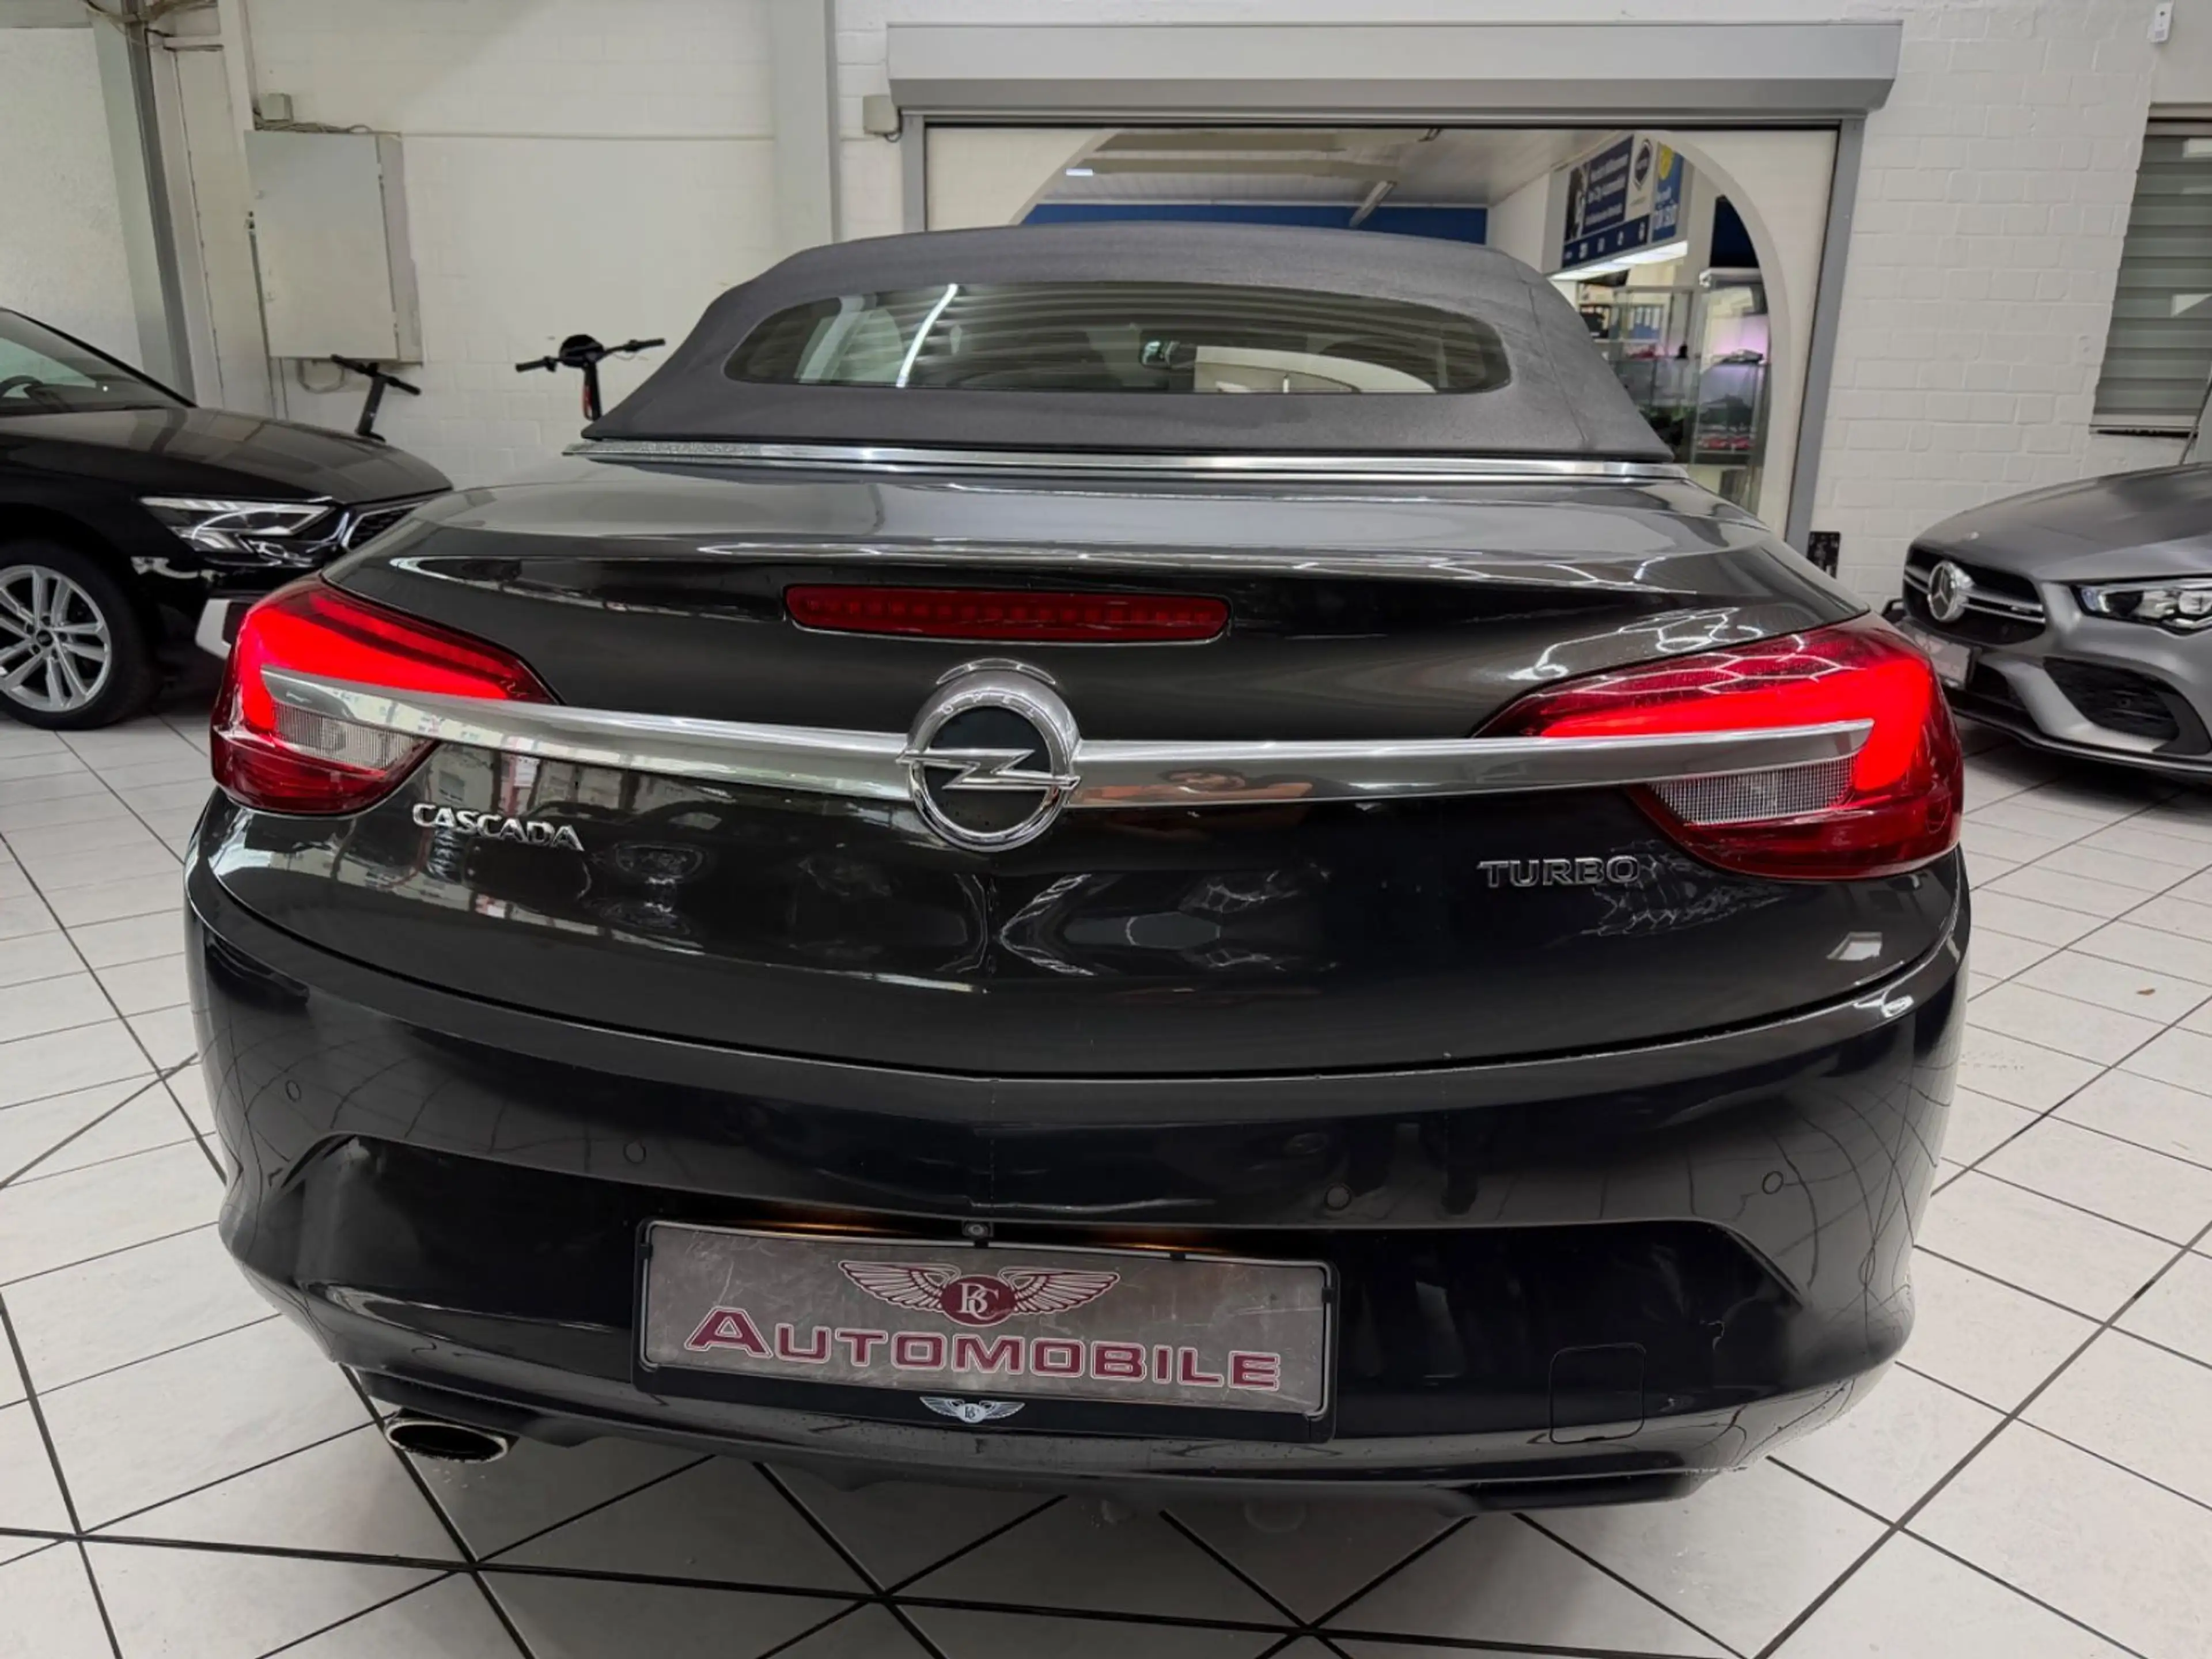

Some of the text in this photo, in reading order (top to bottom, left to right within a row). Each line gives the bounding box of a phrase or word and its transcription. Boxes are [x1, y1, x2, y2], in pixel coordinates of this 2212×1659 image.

[413, 803, 585, 851] CASCADA
[1477, 855, 1641, 888] TURBO
[684, 1306, 1280, 1391] AUTOMOBILE
